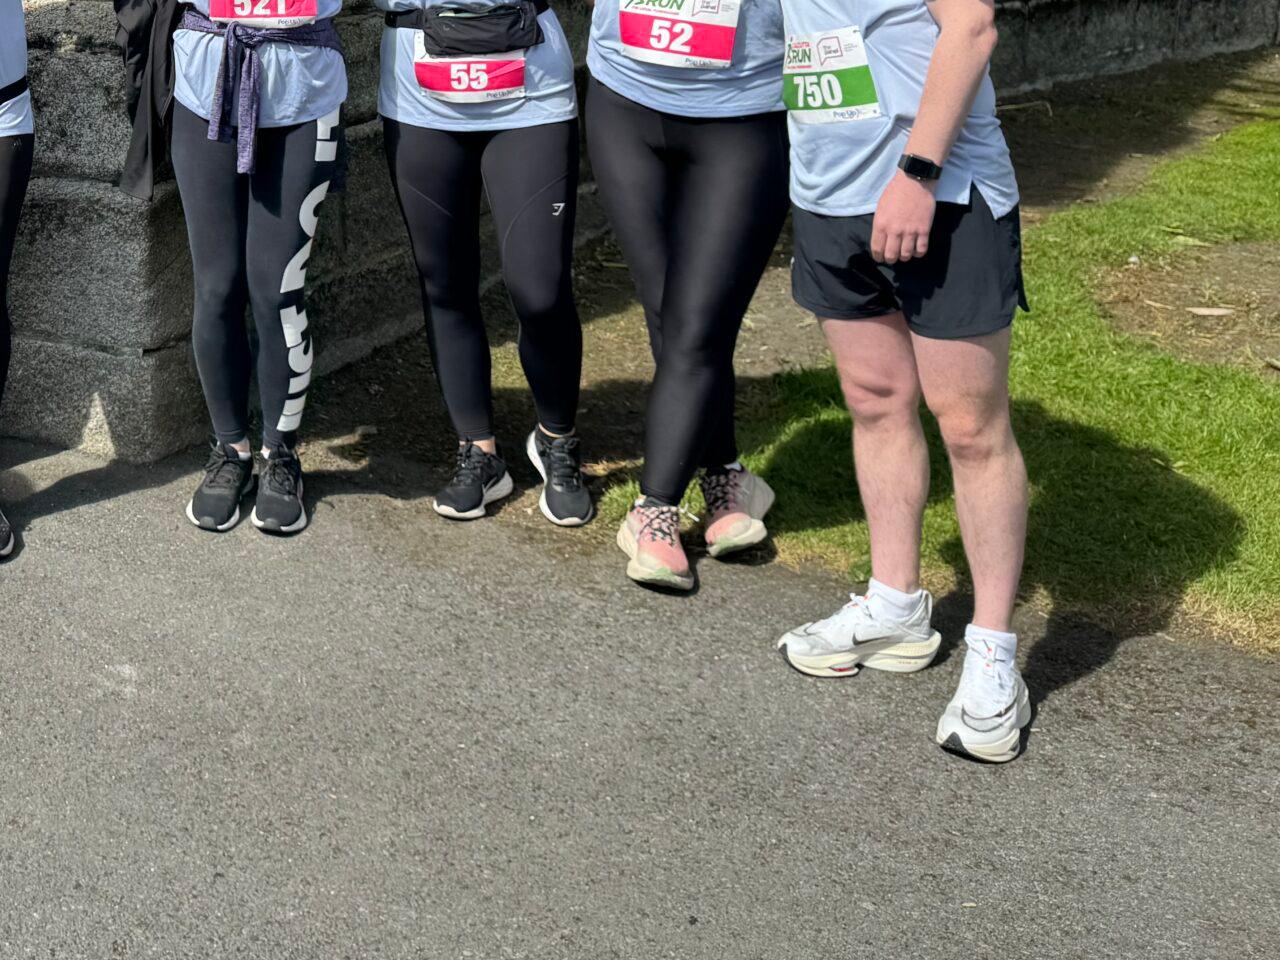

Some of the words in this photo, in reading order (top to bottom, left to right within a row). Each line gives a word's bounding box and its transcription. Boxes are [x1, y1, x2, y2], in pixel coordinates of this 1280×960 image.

[649, 19, 694, 53] 52
[791, 48, 811, 64] RUN
[450, 64, 488, 90] 55
[793, 74, 843, 108] 750
